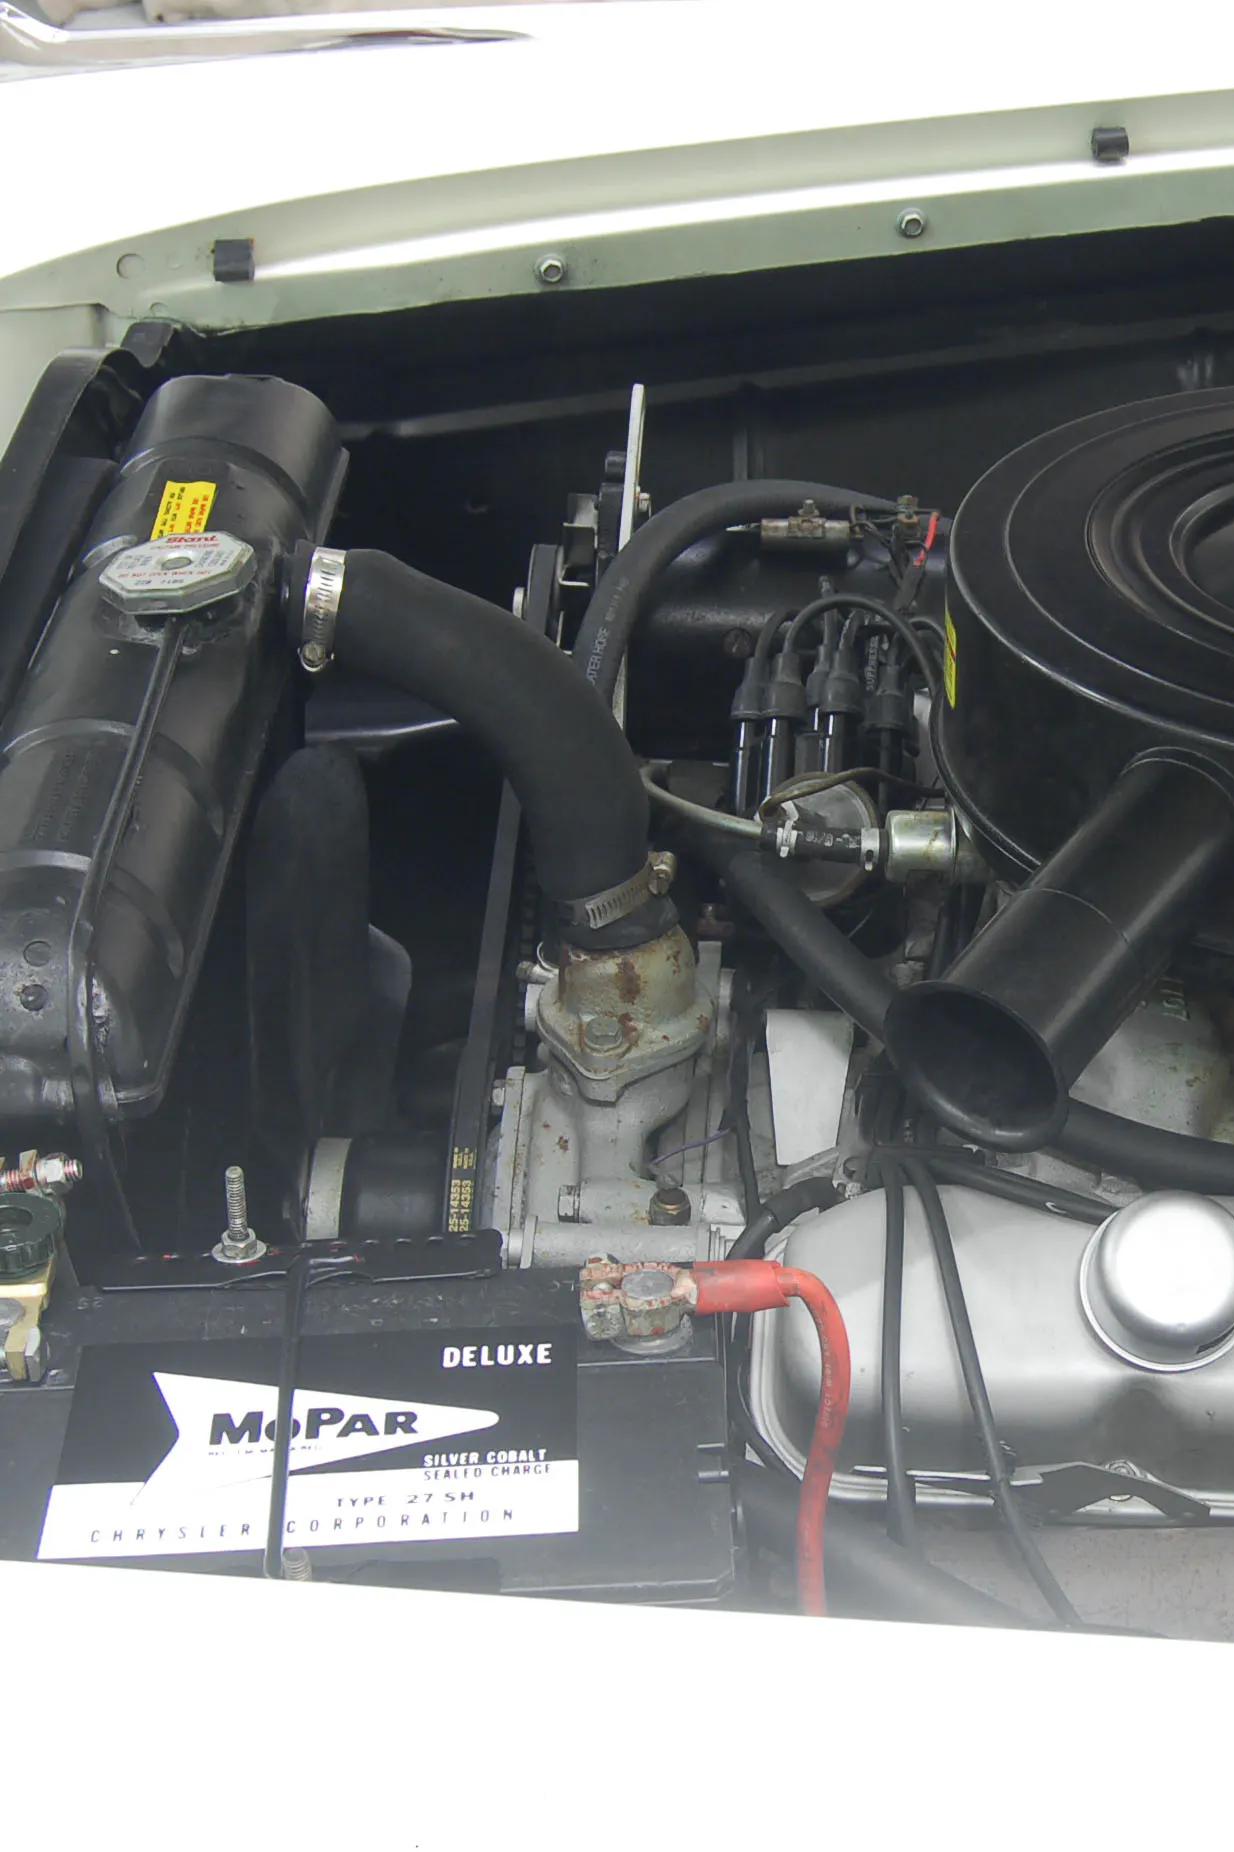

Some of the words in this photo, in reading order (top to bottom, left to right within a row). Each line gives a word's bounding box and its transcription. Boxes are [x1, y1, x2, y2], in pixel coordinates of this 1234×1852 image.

[442, 1343, 552, 1369] DELUXE
[423, 1452, 480, 1467] SILVER
[486, 1449, 547, 1464] COBALT
[424, 1467, 483, 1482] SEALED
[490, 1464, 551, 1477] CHARGE
[337, 1495, 387, 1508] TYPE
[90, 1523, 251, 1543] CHRYSLER
[285, 1508, 514, 1534] CORPORATION
